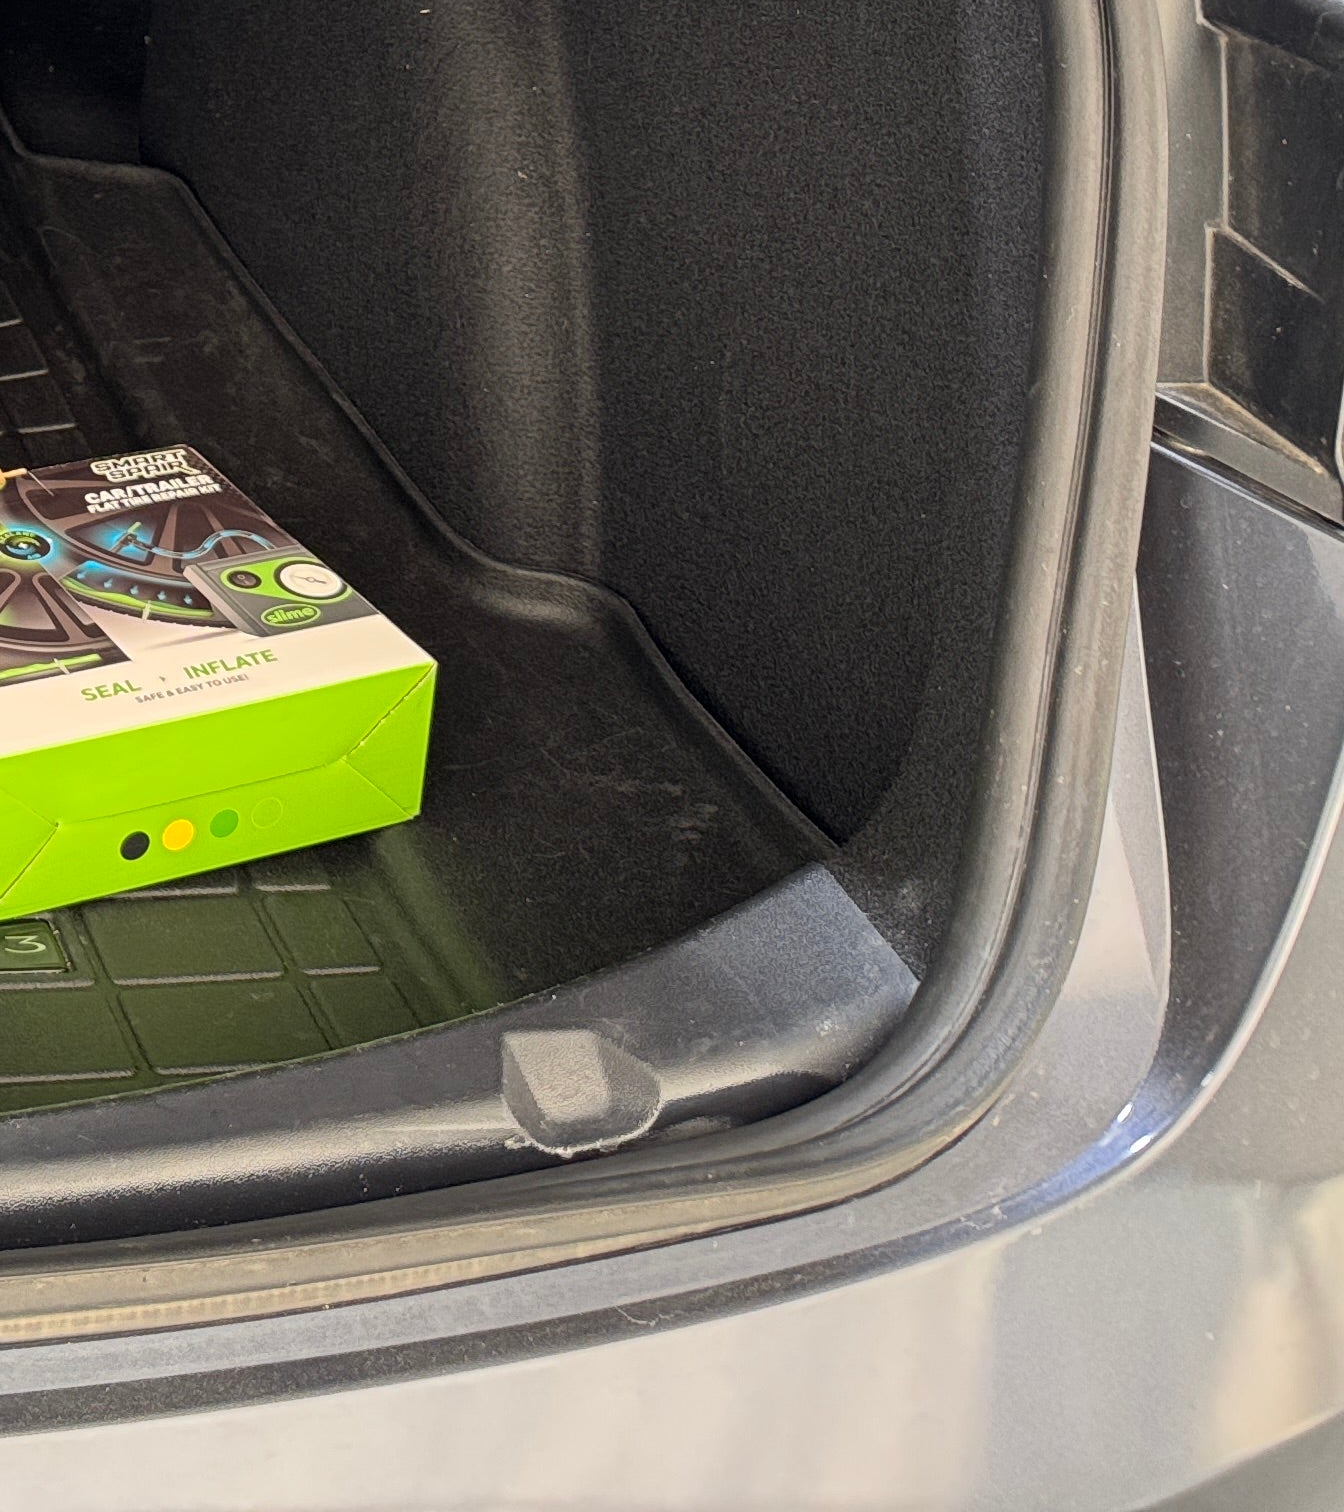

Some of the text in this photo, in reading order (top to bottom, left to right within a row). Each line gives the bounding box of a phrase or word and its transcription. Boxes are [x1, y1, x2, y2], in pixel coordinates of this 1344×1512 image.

[93, 450, 183, 473] SMART
[108, 461, 194, 480] SPAIR
[84, 474, 214, 504] CAR/TRAILER
[86, 483, 223, 514] FLAT TIRE REPAIR KIT
[267, 607, 316, 625] slime
[80, 649, 278, 702] SEAL INFLATE
[135, 673, 250, 704] SAFE & EASY TO USE!
[4, 935, 47, 953] 3
